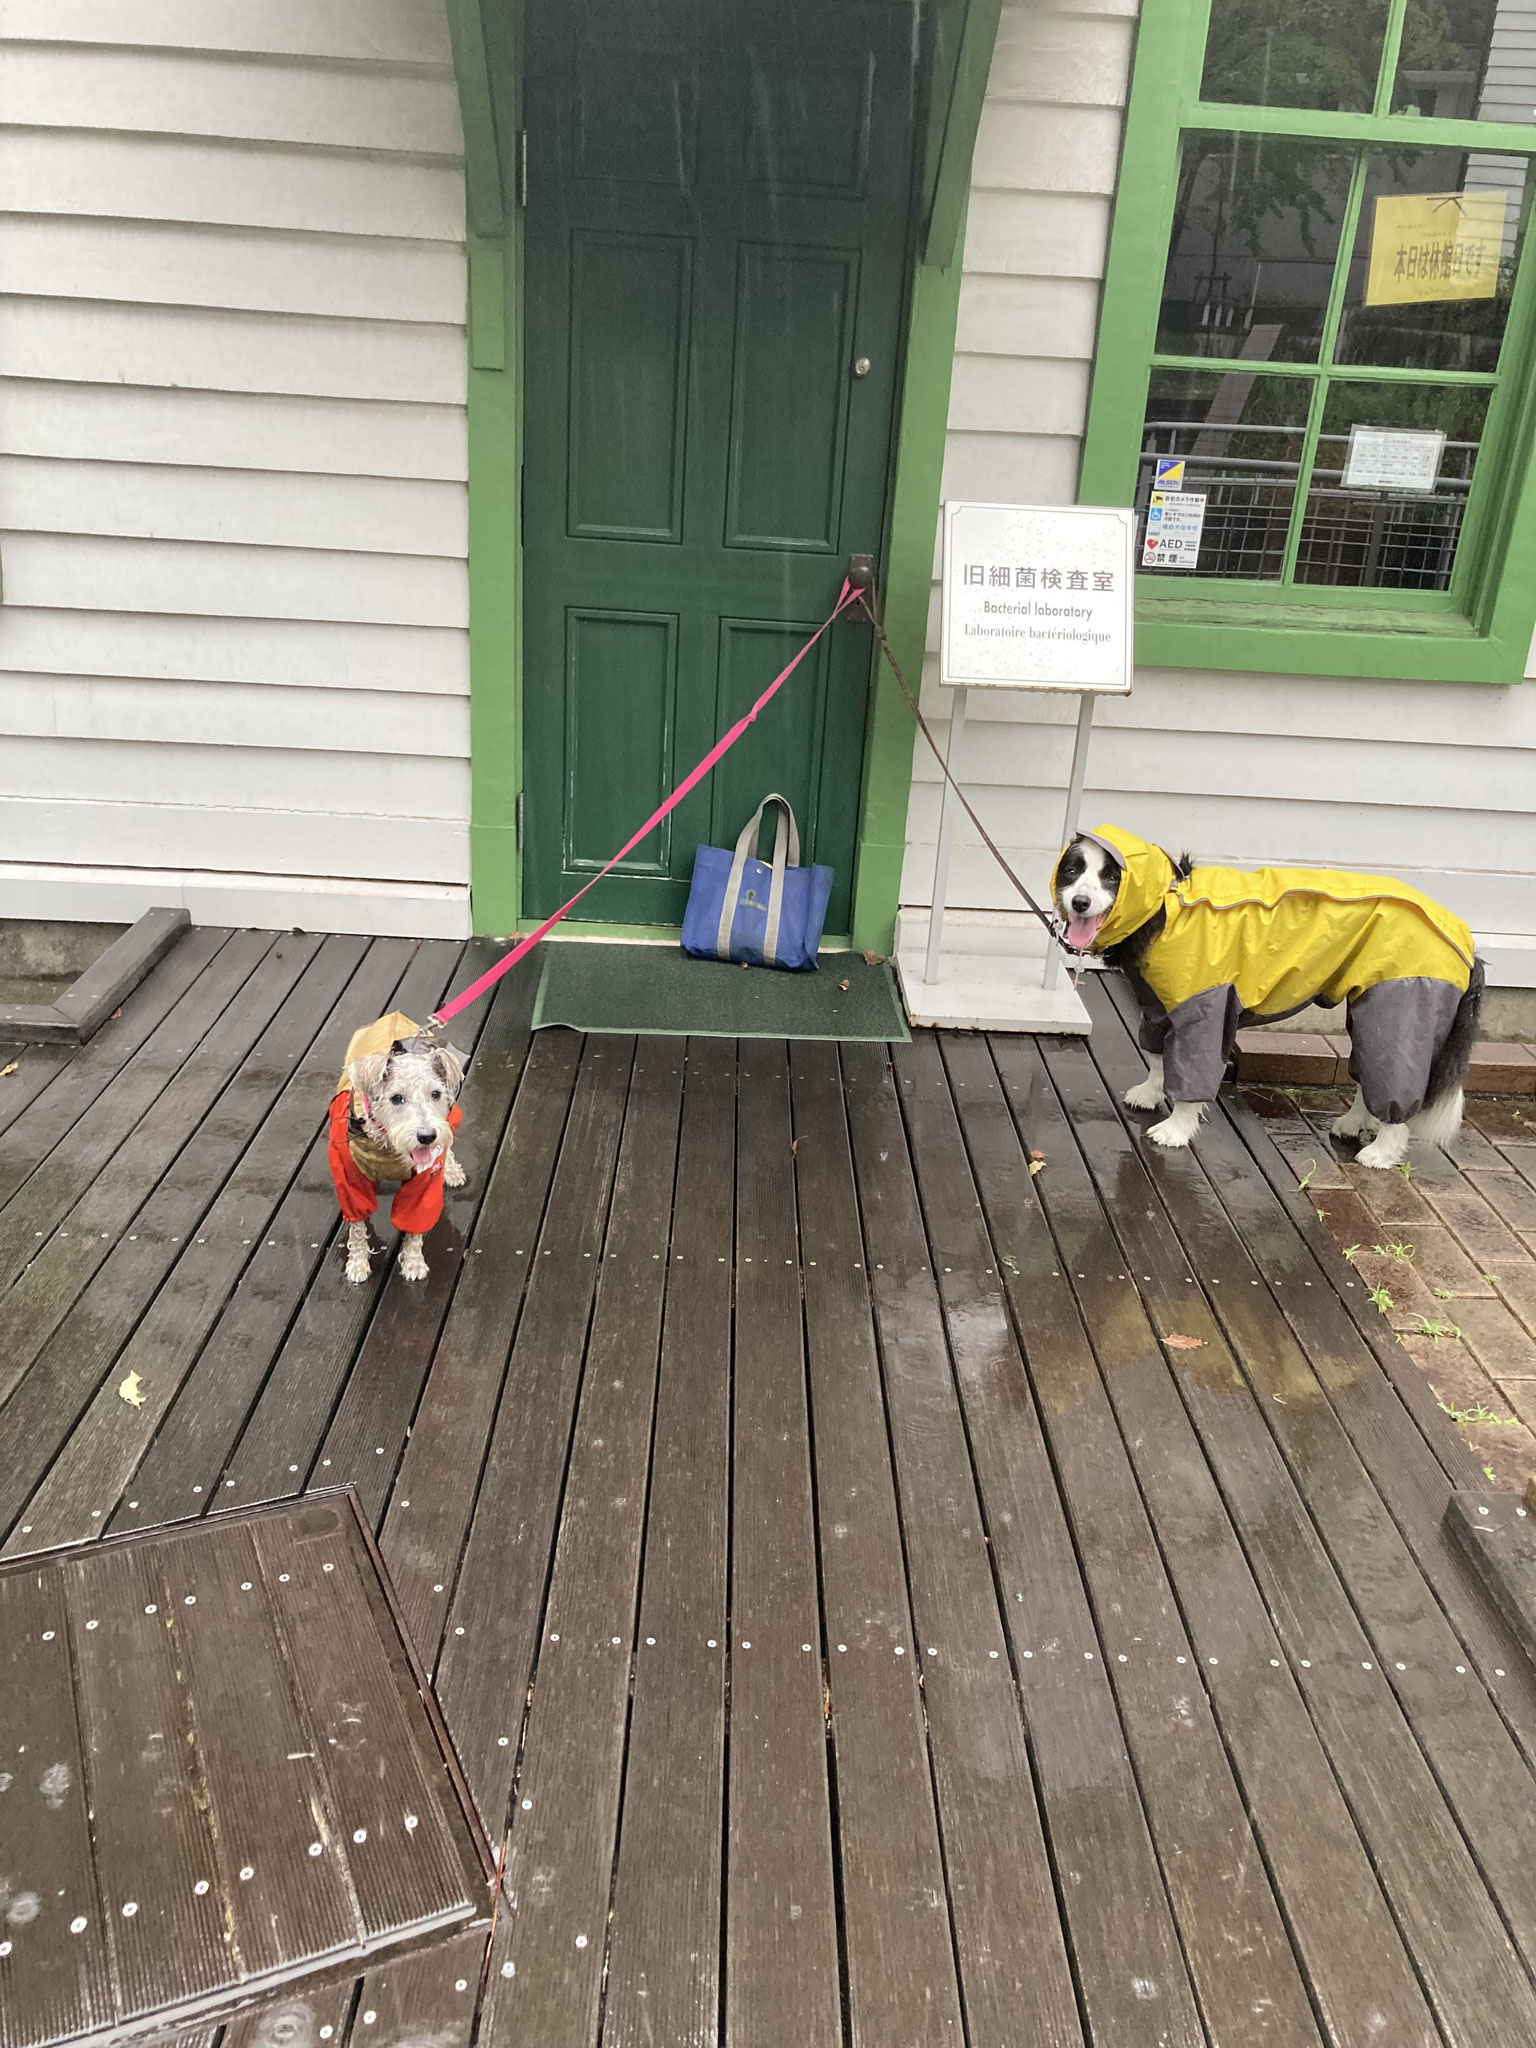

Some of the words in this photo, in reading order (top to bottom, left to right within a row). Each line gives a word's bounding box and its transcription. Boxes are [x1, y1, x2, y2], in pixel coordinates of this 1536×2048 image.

[1393, 238, 1487, 284] 本日は休館日です
[1159, 539, 1183, 549] AED
[1156, 553, 1178, 563] 禁煙
[963, 563, 1115, 592] 旧細菌検査室
[983, 601, 1031, 616] Bacterial
[1034, 602, 1093, 621] laboratory
[964, 623, 1026, 638] Laboratoire
[1029, 626, 1111, 645] bactériologique
